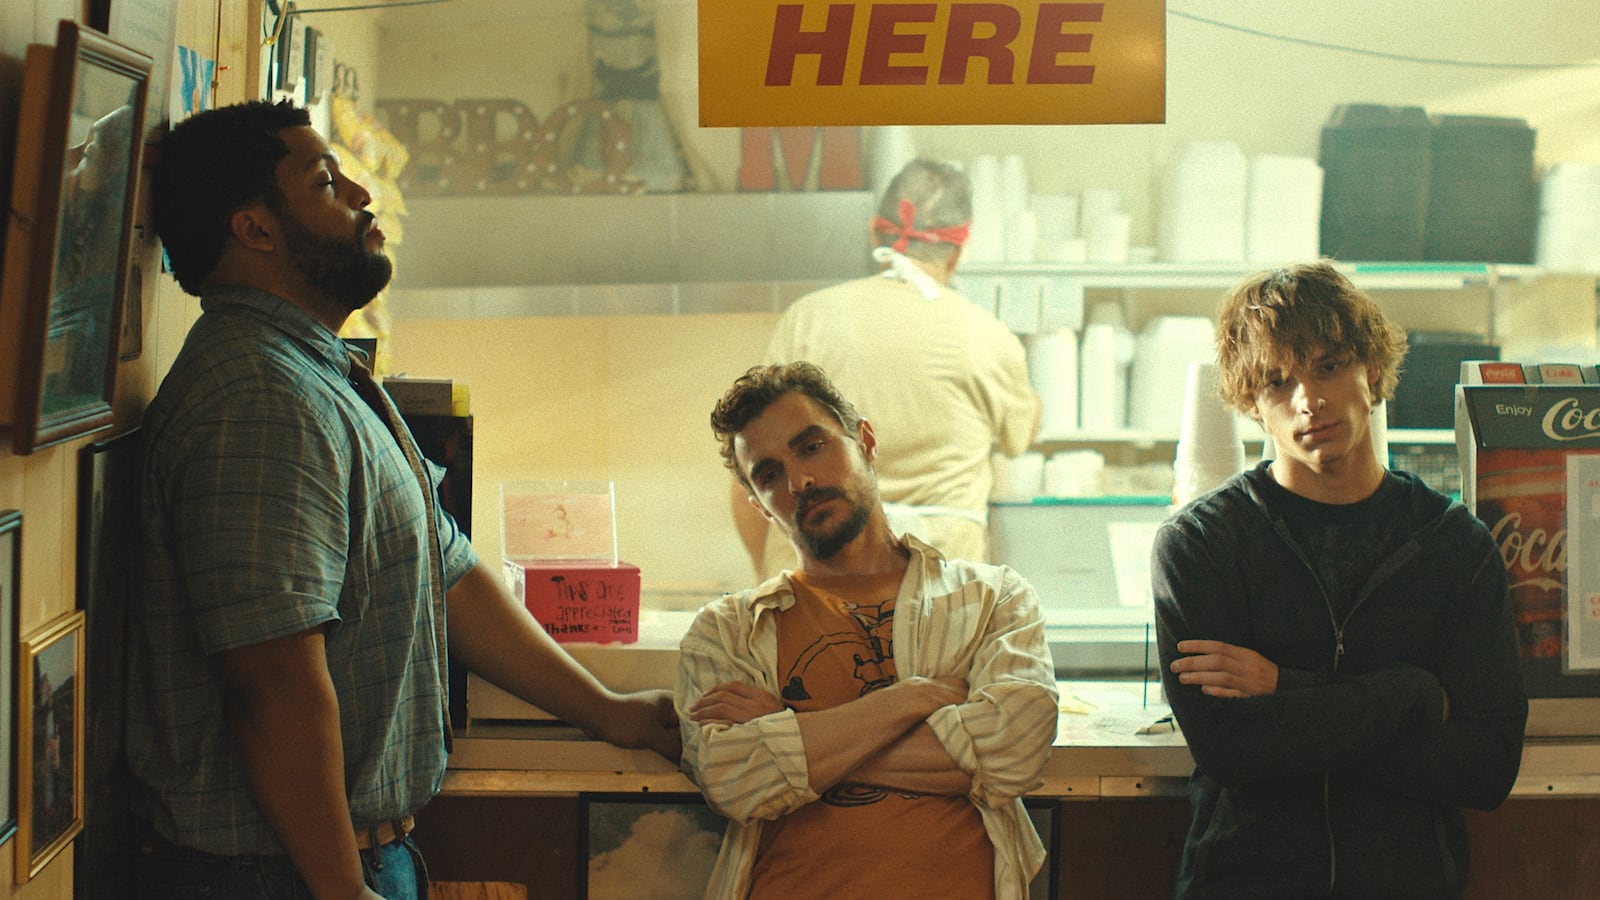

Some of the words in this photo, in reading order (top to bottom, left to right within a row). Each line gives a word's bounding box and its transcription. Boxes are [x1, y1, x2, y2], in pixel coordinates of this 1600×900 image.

[764, 3, 1103, 87] HERE
[376, 97, 648, 195] BBQ
[1495, 403, 1533, 417] Enjoy
